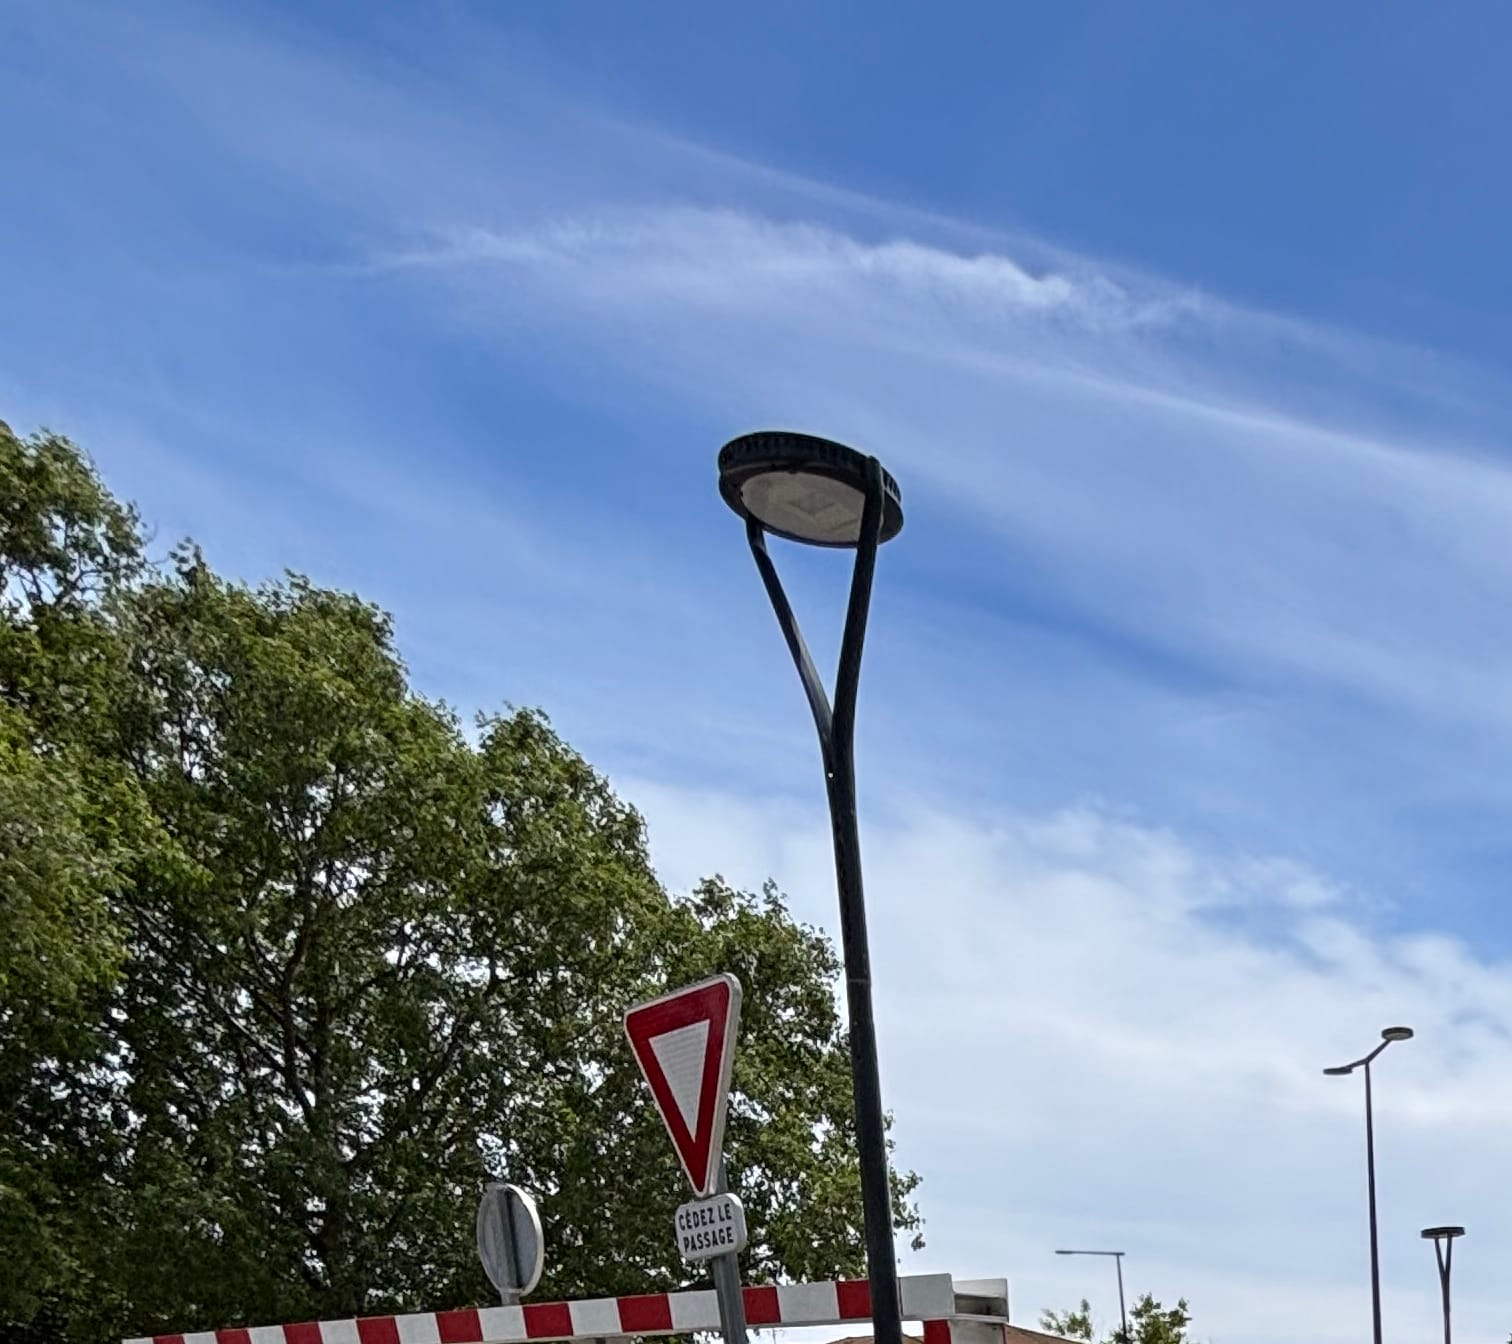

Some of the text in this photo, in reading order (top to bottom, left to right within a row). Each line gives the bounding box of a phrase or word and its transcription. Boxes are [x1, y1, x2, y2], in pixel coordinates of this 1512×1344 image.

[678, 1203, 732, 1231] CÉDEZ LE
[683, 1226, 734, 1253] PASSAGE
